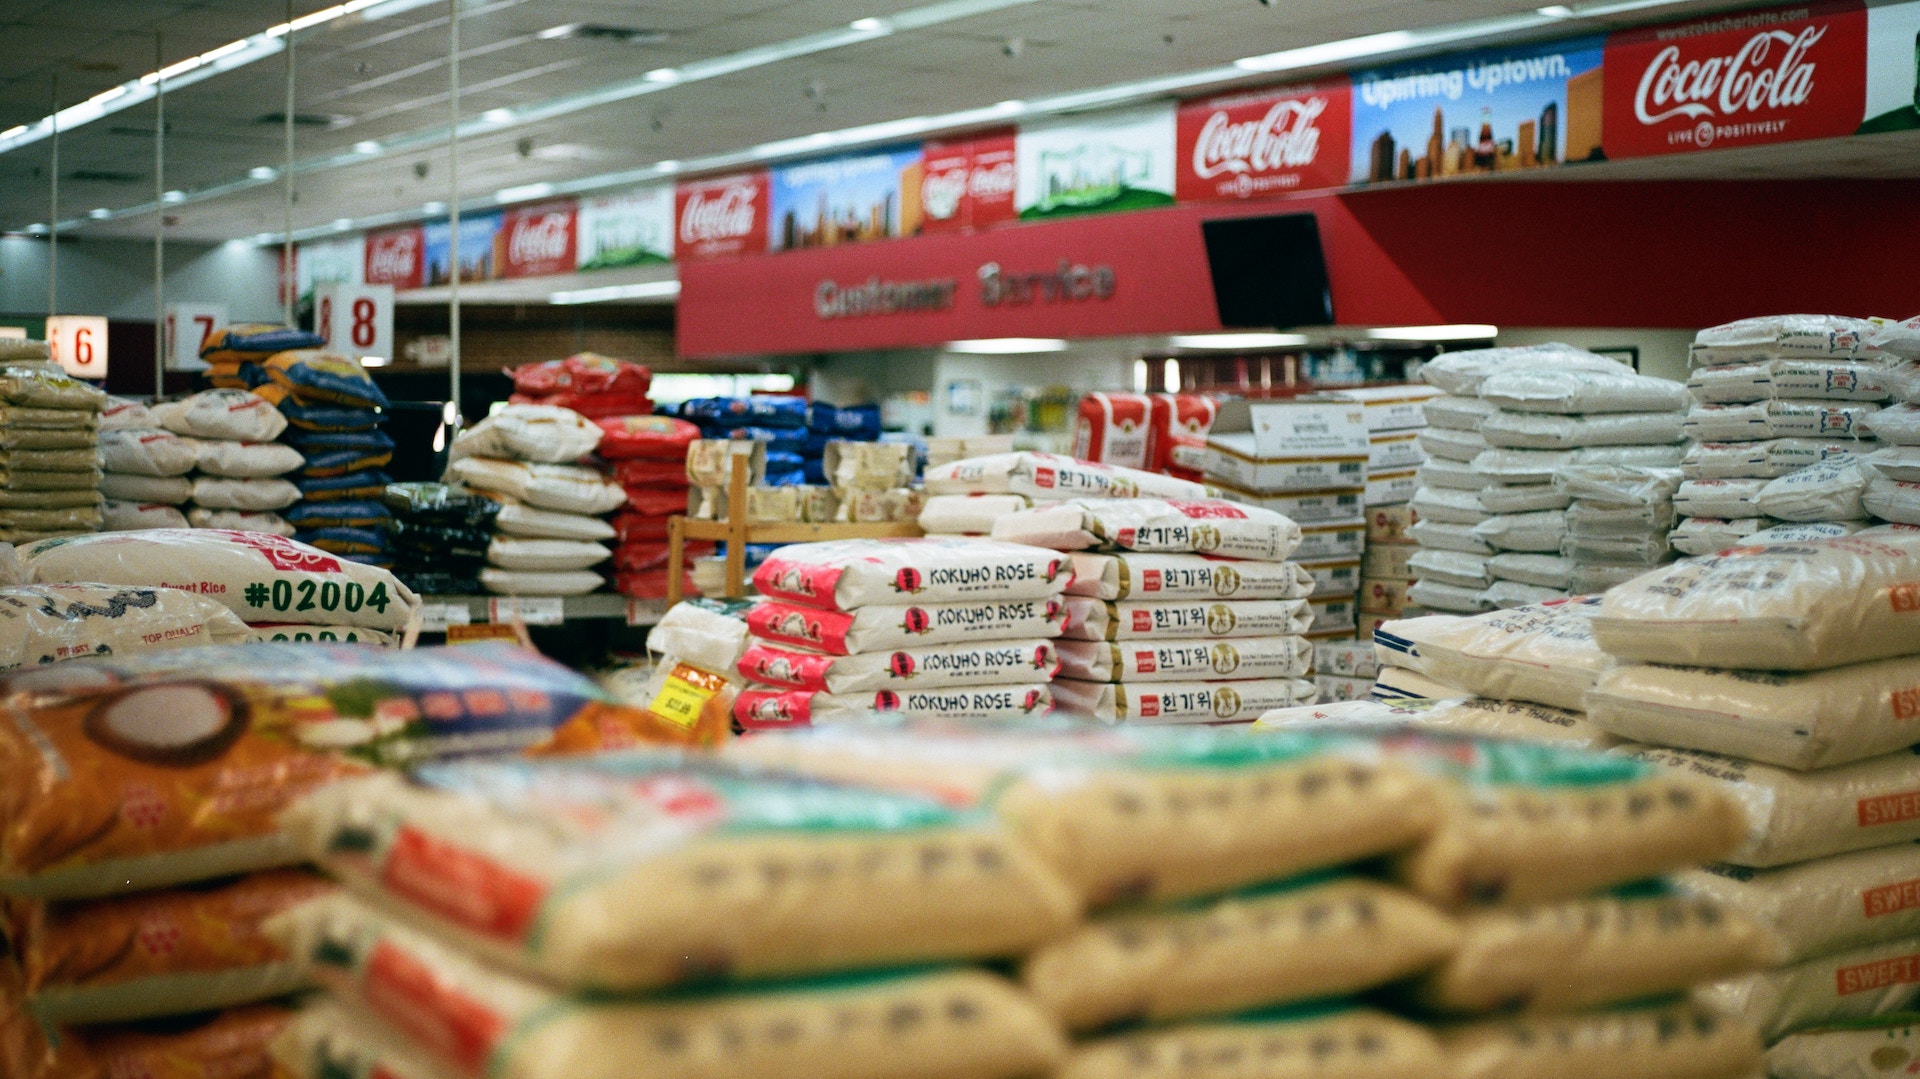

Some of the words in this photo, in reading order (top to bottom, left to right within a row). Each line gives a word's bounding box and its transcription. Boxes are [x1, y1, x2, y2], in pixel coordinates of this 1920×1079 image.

[1362, 68, 1464, 110] Uplifting
[1467, 54, 1572, 94] Uptown.
[1667, 129, 1693, 145] LIVE
[1716, 119, 1788, 140] POSITIVELY
[815, 273, 957, 321] Customer
[977, 258, 1117, 309] Service
[192, 313, 215, 358] 7
[351, 297, 376, 348] 8
[75, 326, 93, 366] 6
[1812, 525, 1842, 536] THAILAND
[200, 581, 226, 594] Rice
[930, 565, 991, 586] KOKUHO
[996, 563, 1036, 582] ROSE
[244, 578, 390, 615] #02004
[937, 604, 994, 627] KOKUHO
[999, 601, 1036, 621] ROSE
[142, 631, 162, 645] TOP
[165, 623, 204, 641] QUALIT
[923, 649, 981, 671] KOKUHO
[985, 647, 1023, 667] ROSE
[908, 692, 970, 712] KOKUHO
[973, 692, 1013, 710] ROSE
[1507, 704, 1524, 714] OF
[1526, 708, 1576, 727] THAILAND
